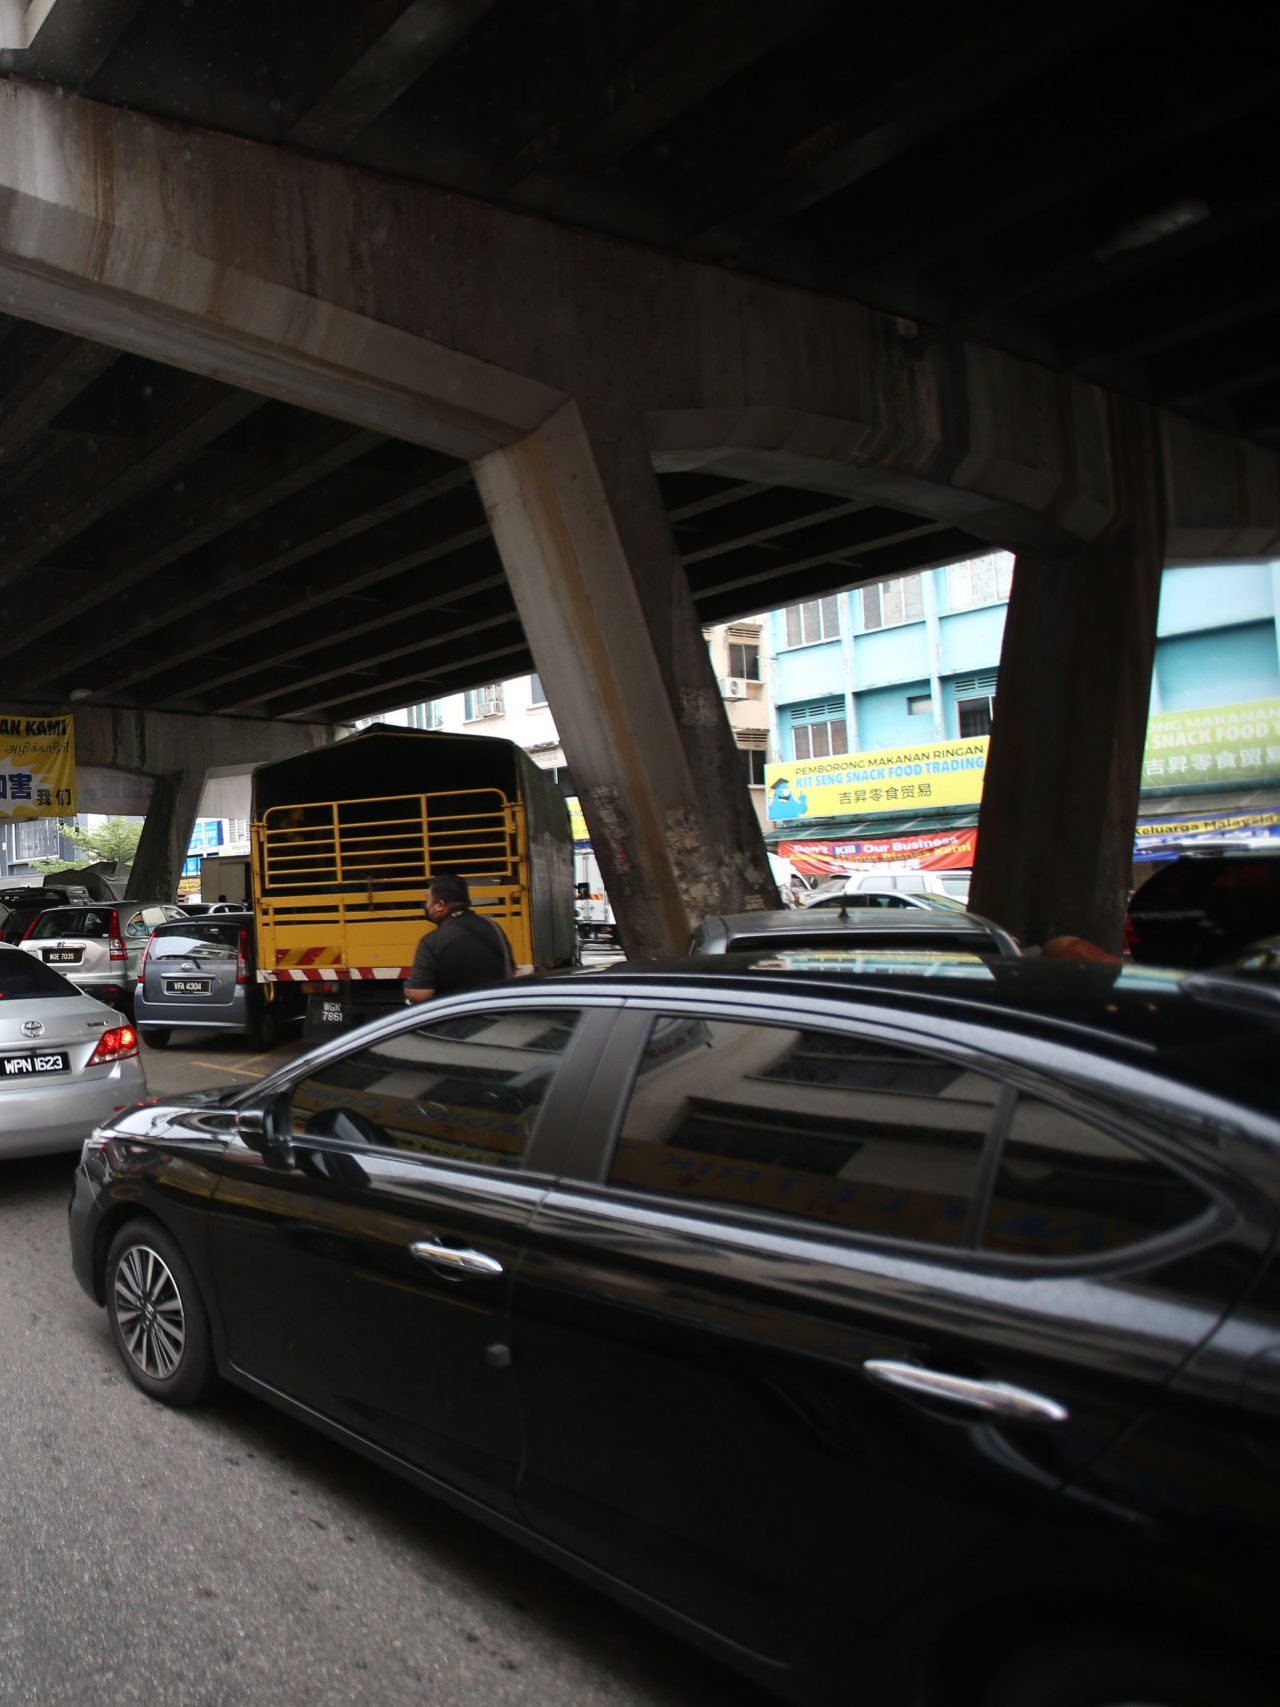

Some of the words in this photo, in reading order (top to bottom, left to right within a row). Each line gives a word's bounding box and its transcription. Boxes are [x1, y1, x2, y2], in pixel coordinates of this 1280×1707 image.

[24, 719, 67, 737] KAMI
[1152, 728, 1212, 750] SNACK
[1216, 722, 1269, 743] FOOD
[795, 760, 865, 776] PEMBORONG
[868, 751, 930, 768] MAKANAN
[933, 745, 984, 760] RINGAN
[795, 774, 817, 788] KIT
[815, 771, 843, 786] SENG
[846, 767, 886, 784] SNACK
[888, 762, 923, 779] FOOD
[926, 755, 985, 775] TRADING
[834, 845, 857, 856] Kill
[863, 842, 890, 854] Our
[892, 835, 960, 851] Business
[174, 982, 185, 990] VFA
[186, 982, 202, 991] 4304
[322, 1011, 343, 1022] 7861
[4, 1059, 33, 1075] WPN
[34, 1055, 63, 1072] 1623
